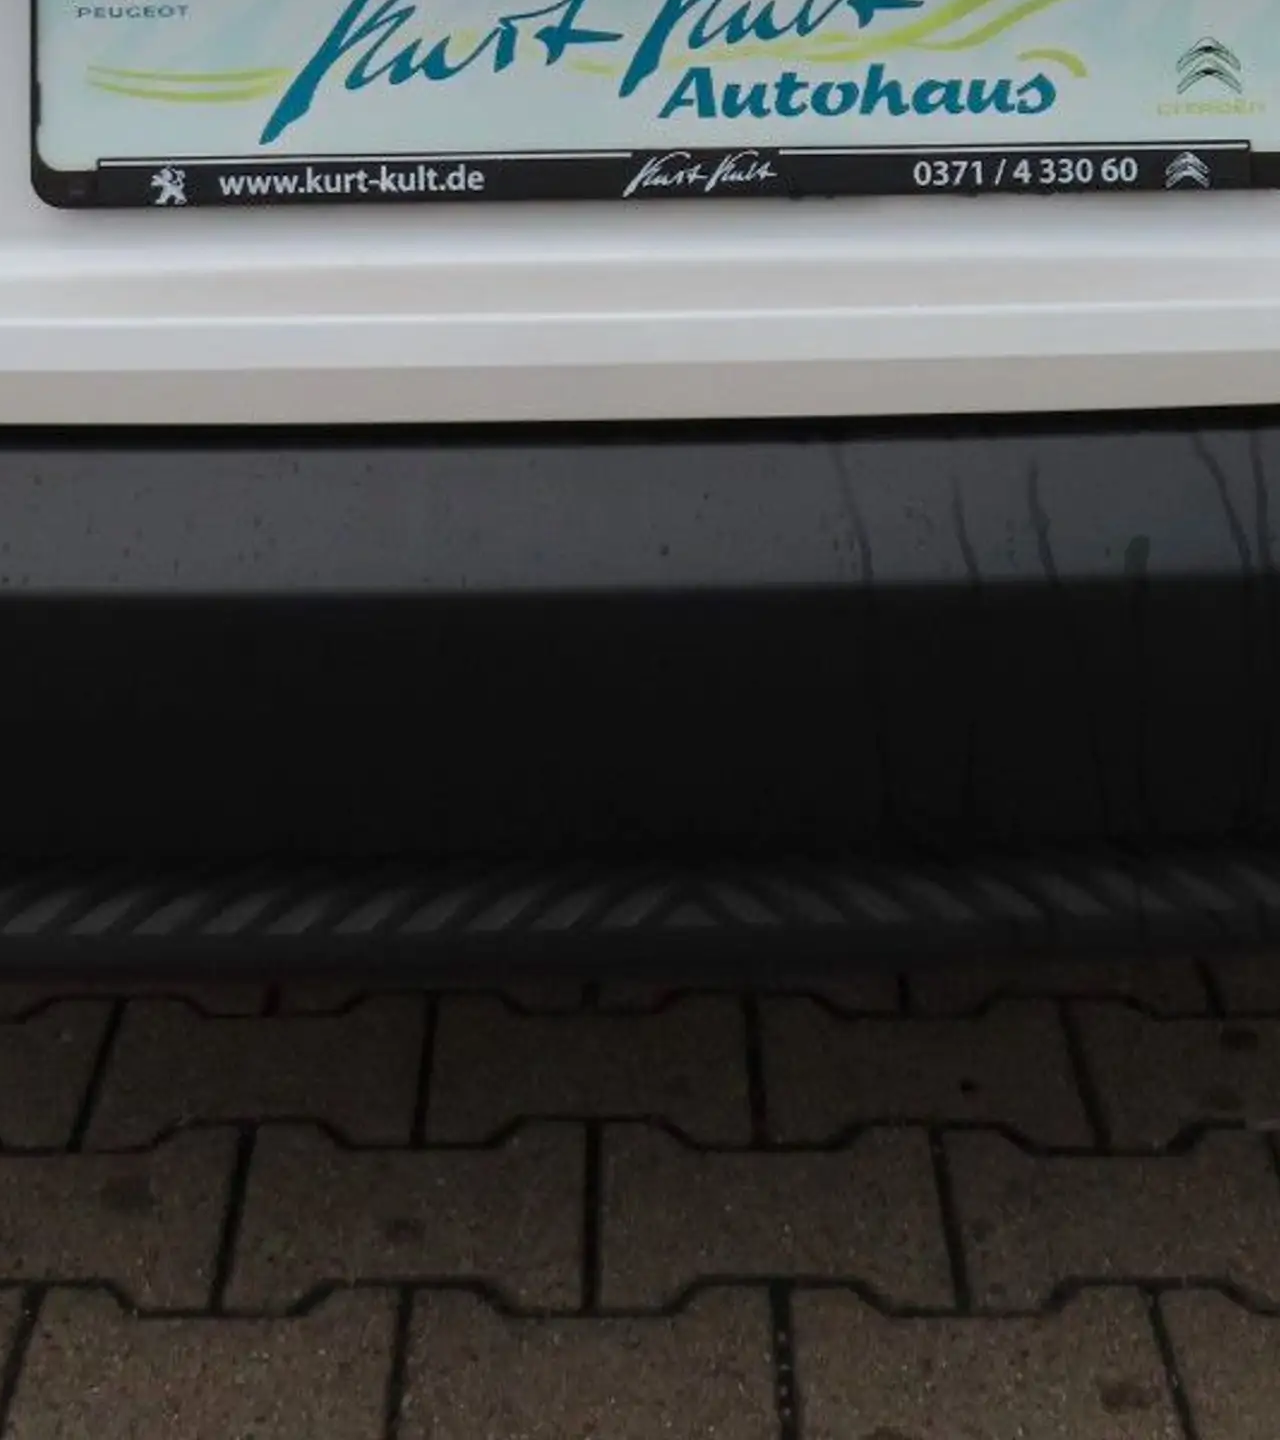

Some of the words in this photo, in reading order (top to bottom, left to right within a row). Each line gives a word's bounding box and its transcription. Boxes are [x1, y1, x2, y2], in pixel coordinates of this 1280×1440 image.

[76, 3, 190, 19] PEUGEOT
[657, 62, 1058, 121] Autohaus
[218, 164, 486, 196] www.kurt-kult.de
[622, 150, 708, 198] Kurt
[704, 149, 778, 192] Kult
[913, 159, 984, 187] 0371
[1012, 159, 1032, 184] 4
[1039, 157, 1094, 185] 330
[1100, 157, 1139, 183] 60
